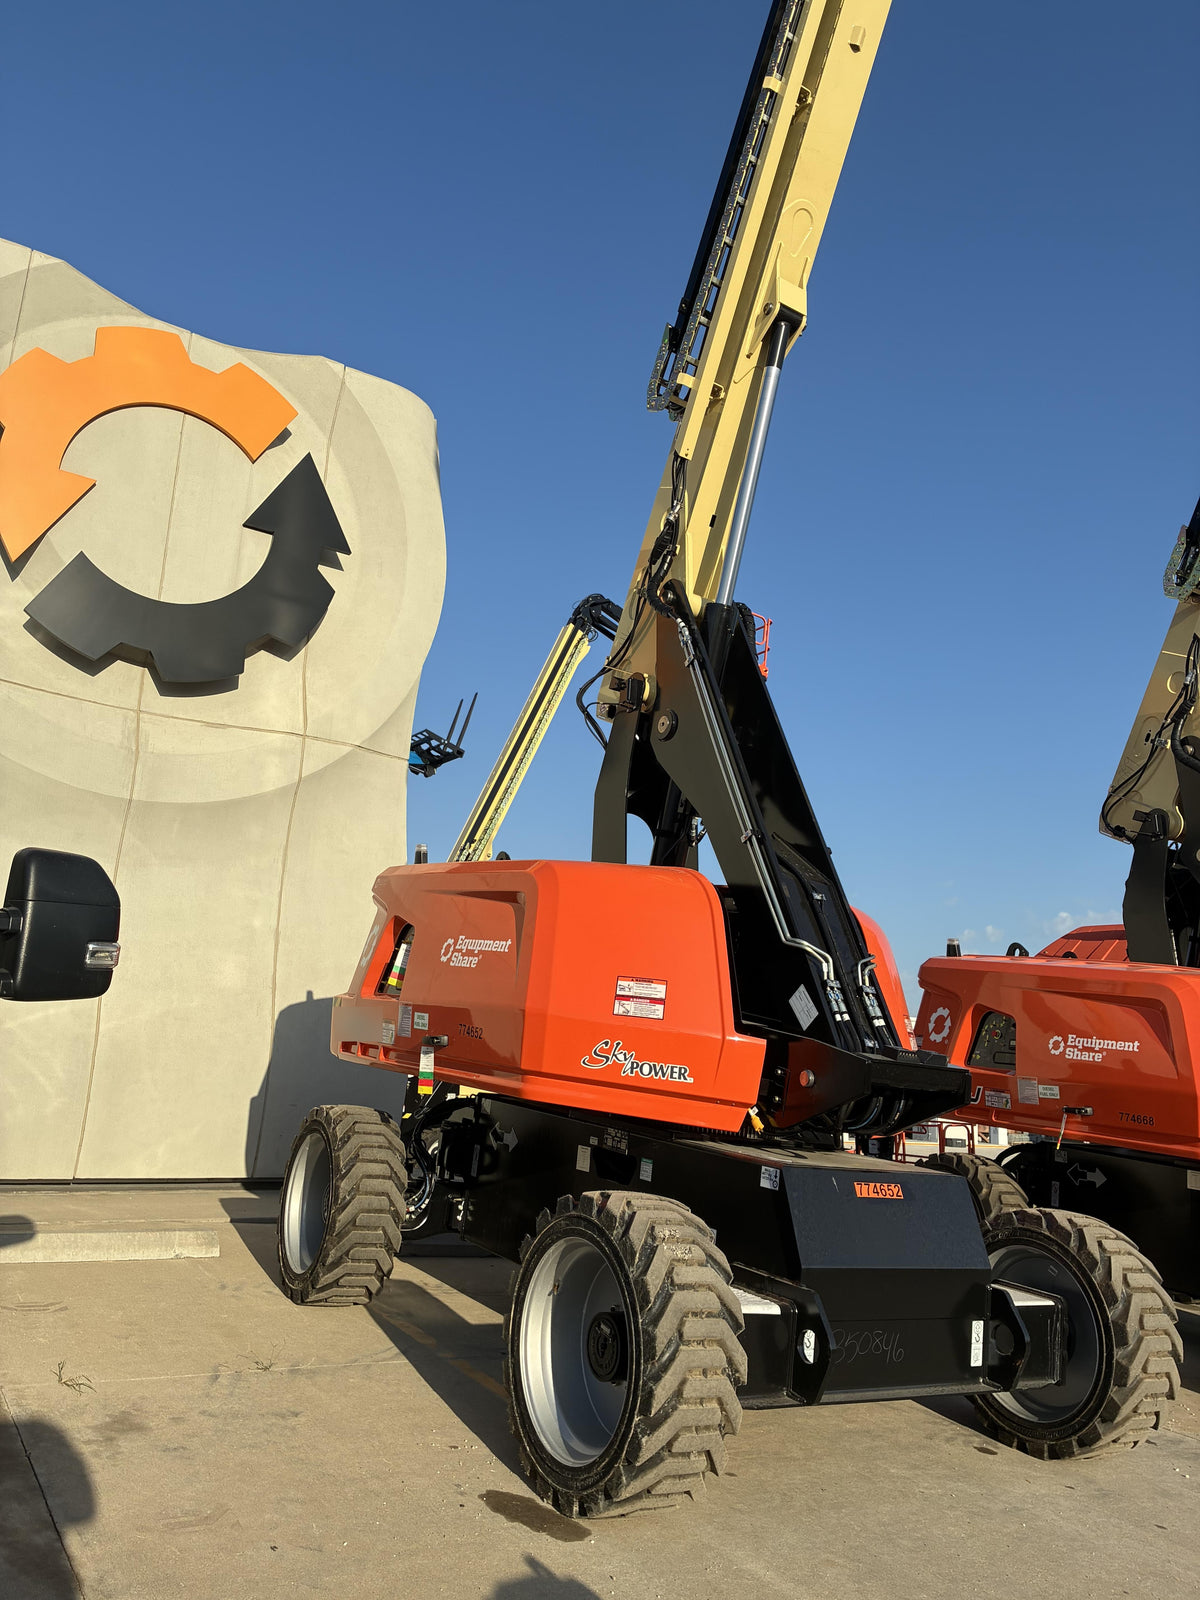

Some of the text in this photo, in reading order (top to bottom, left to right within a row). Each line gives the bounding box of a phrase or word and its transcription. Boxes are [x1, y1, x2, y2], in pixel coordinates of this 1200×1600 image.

[455, 935, 512, 953] Equipment
[449, 952, 479, 968] Share
[458, 1023, 483, 1040] 774652
[1067, 1034, 1140, 1052] Equipment
[580, 1039, 635, 1076] Sky
[1065, 1047, 1103, 1062] Share
[629, 1060, 690, 1081] POWER
[1119, 1112, 1154, 1126] 774668
[856, 1183, 902, 1197] 774652
